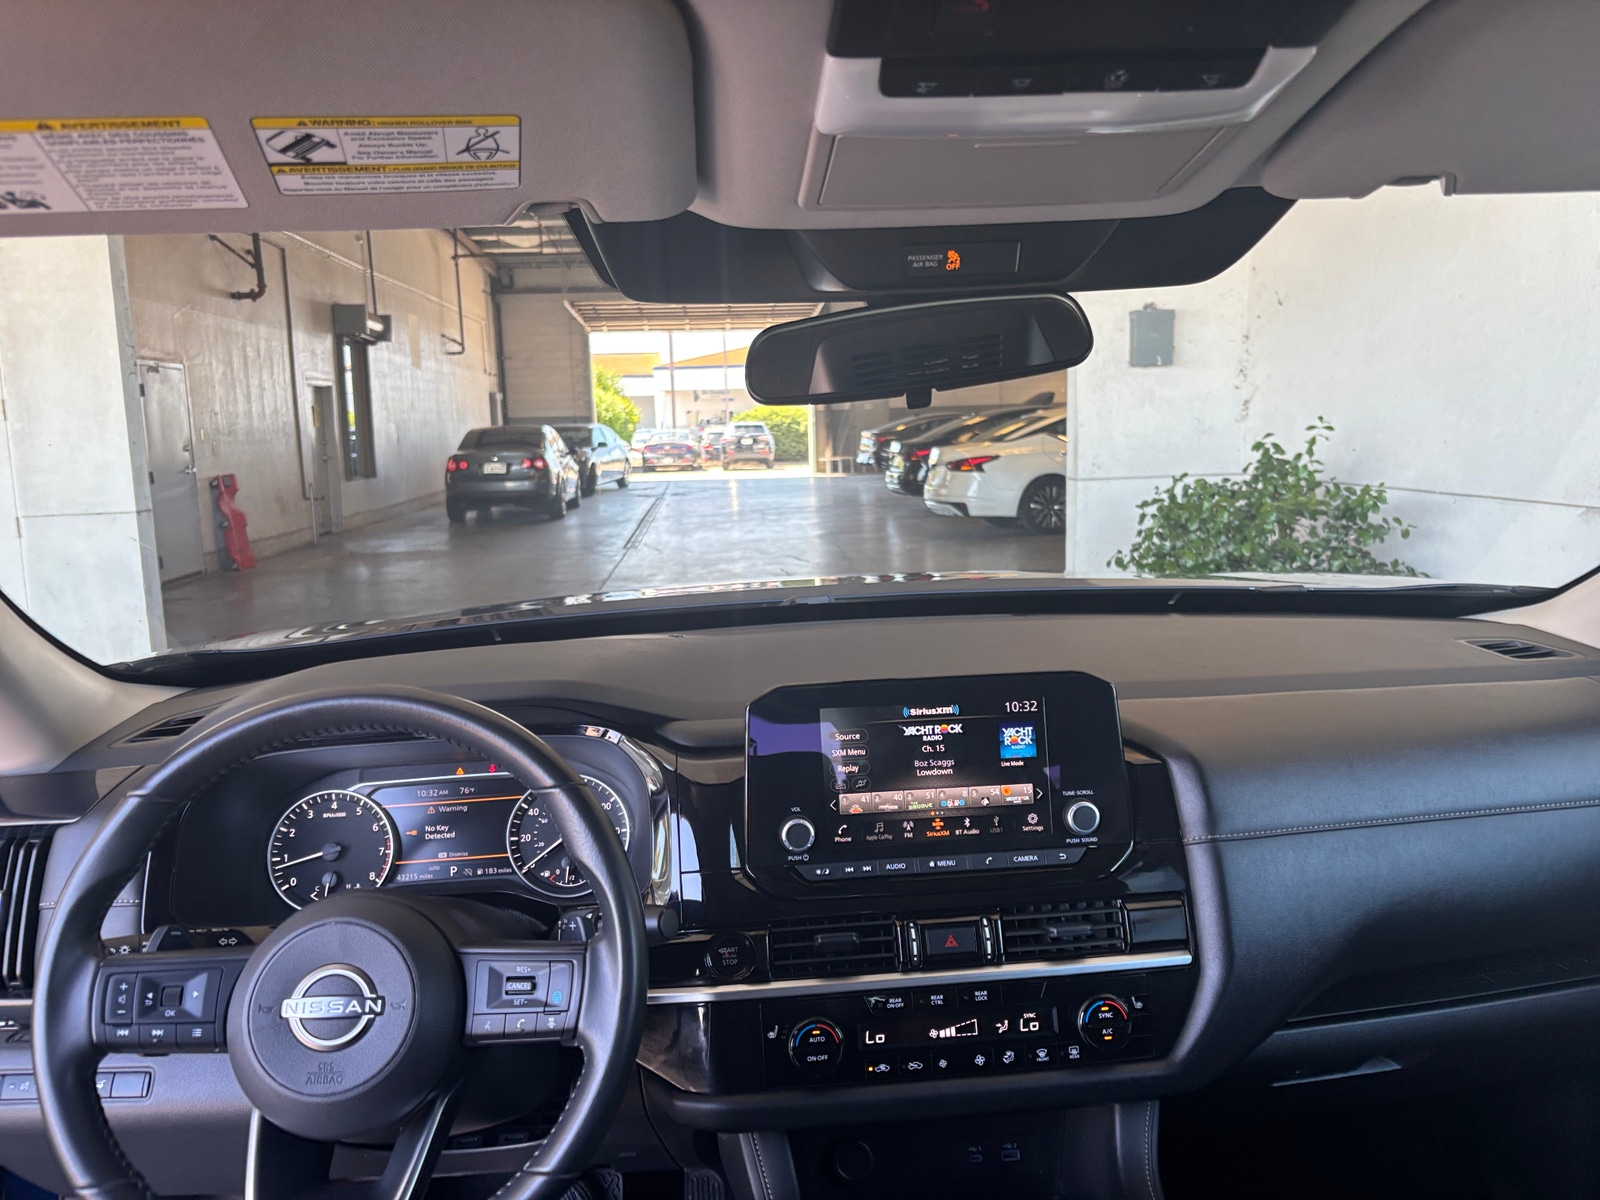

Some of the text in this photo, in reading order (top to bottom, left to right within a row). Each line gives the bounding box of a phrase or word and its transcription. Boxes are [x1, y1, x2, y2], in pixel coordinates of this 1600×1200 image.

[1005, 701, 1038, 712] 10:32
[902, 725, 934, 736] YACHT
[1002, 727, 1033, 737] YACHT
[917, 768, 953, 776] Lowdown
[331, 801, 337, 810] 4
[308, 810, 314, 819] 3
[356, 807, 362, 815] 5
[372, 823, 379, 832] 6
[379, 847, 385, 856] 7
[369, 872, 376, 880] 8
[450, 866, 458, 877] P
[290, 878, 297, 886] 0
[284, 1000, 382, 1014] NISSAN
[1020, 1018, 1039, 1032] Lo
[866, 1030, 885, 1044] Lo
[318, 1062, 335, 1072] SRS
